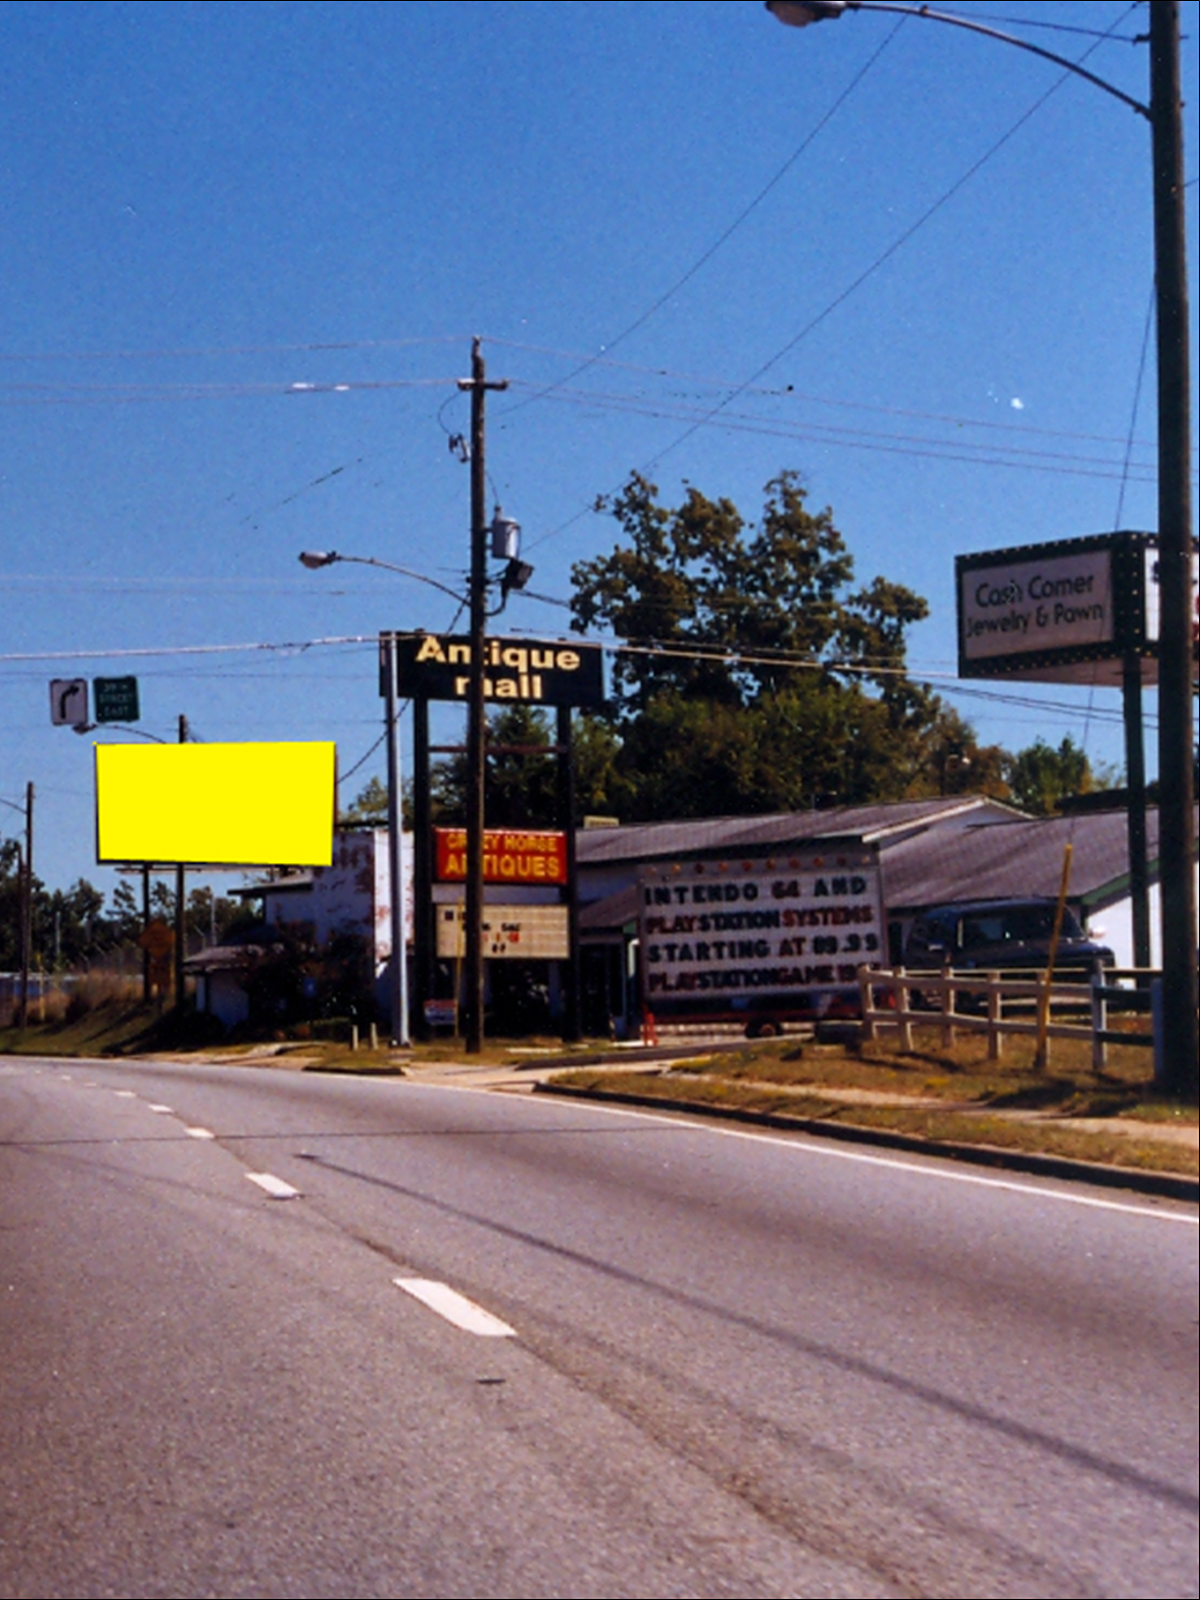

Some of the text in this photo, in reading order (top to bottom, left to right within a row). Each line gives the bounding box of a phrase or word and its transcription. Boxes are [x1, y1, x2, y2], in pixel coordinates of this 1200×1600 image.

[975, 575, 1095, 608] Cash Corner
[966, 602, 1104, 638] Jewelry & Pawn
[415, 634, 581, 673] Anique
[504, 834, 558, 852] HORSE
[644, 876, 867, 906] INTENDO 64 AND
[648, 939, 770, 963] STARTING
[779, 936, 806, 957] AT
